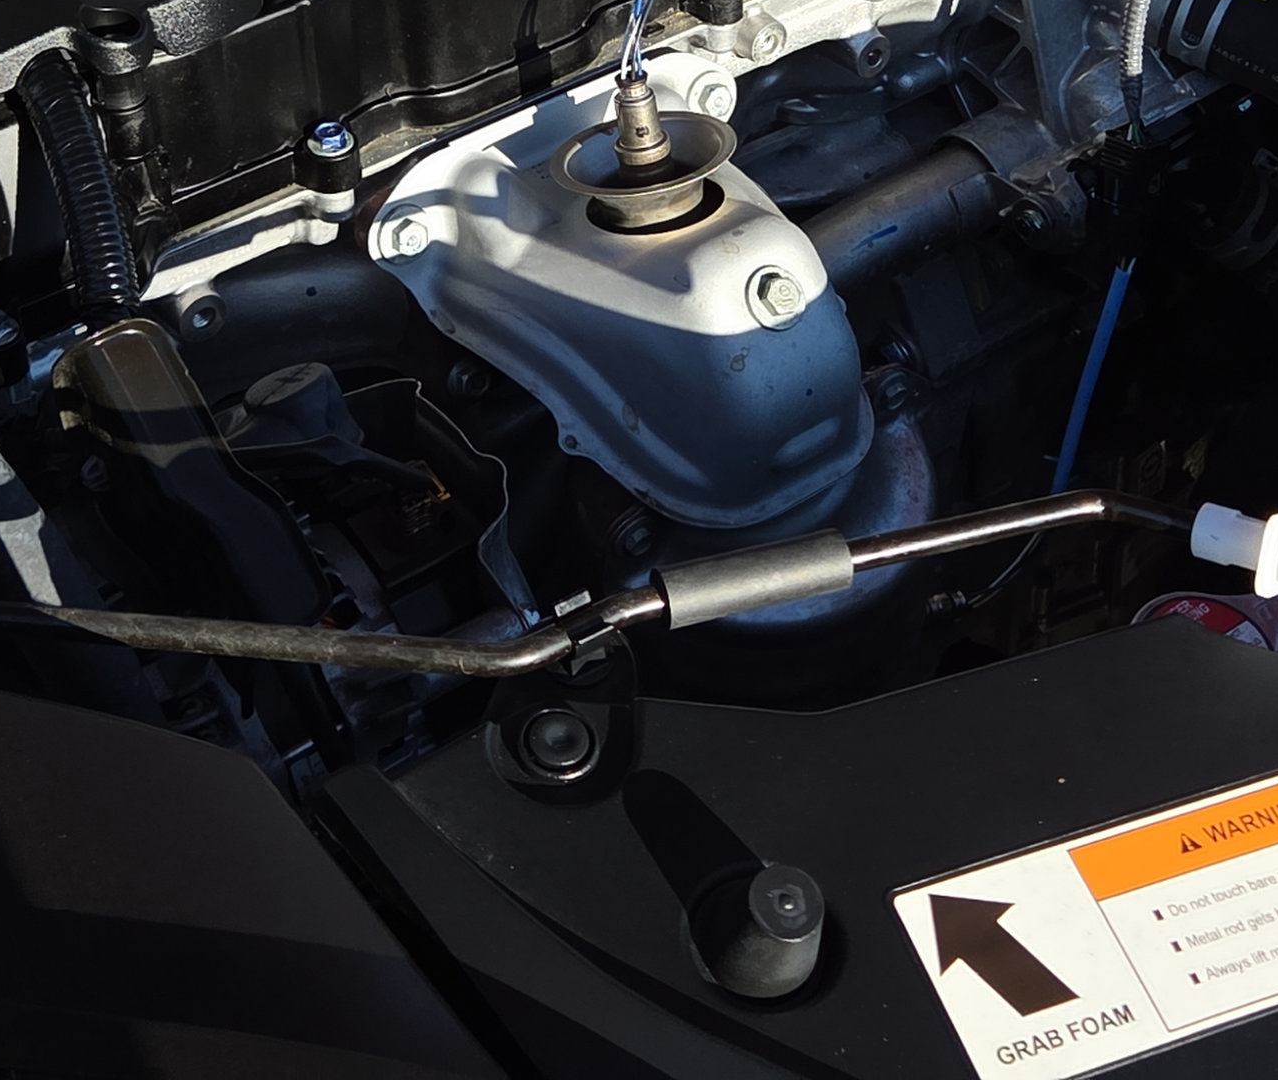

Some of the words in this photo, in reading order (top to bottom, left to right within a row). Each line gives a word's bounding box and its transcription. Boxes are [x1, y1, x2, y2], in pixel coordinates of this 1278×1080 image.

[1167, 904, 1188, 917] Do
[1189, 895, 1212, 910] not
[1212, 885, 1248, 903] touch
[1248, 875, 1278, 891] bare
[1185, 927, 1223, 949] Metal
[1224, 920, 1245, 937] rod
[1247, 912, 1275, 932] gets
[1206, 957, 1251, 981] Always
[1251, 949, 1269, 964] lift
[996, 1029, 1064, 1065] GRAB
[1066, 1004, 1136, 1041] FOAM
